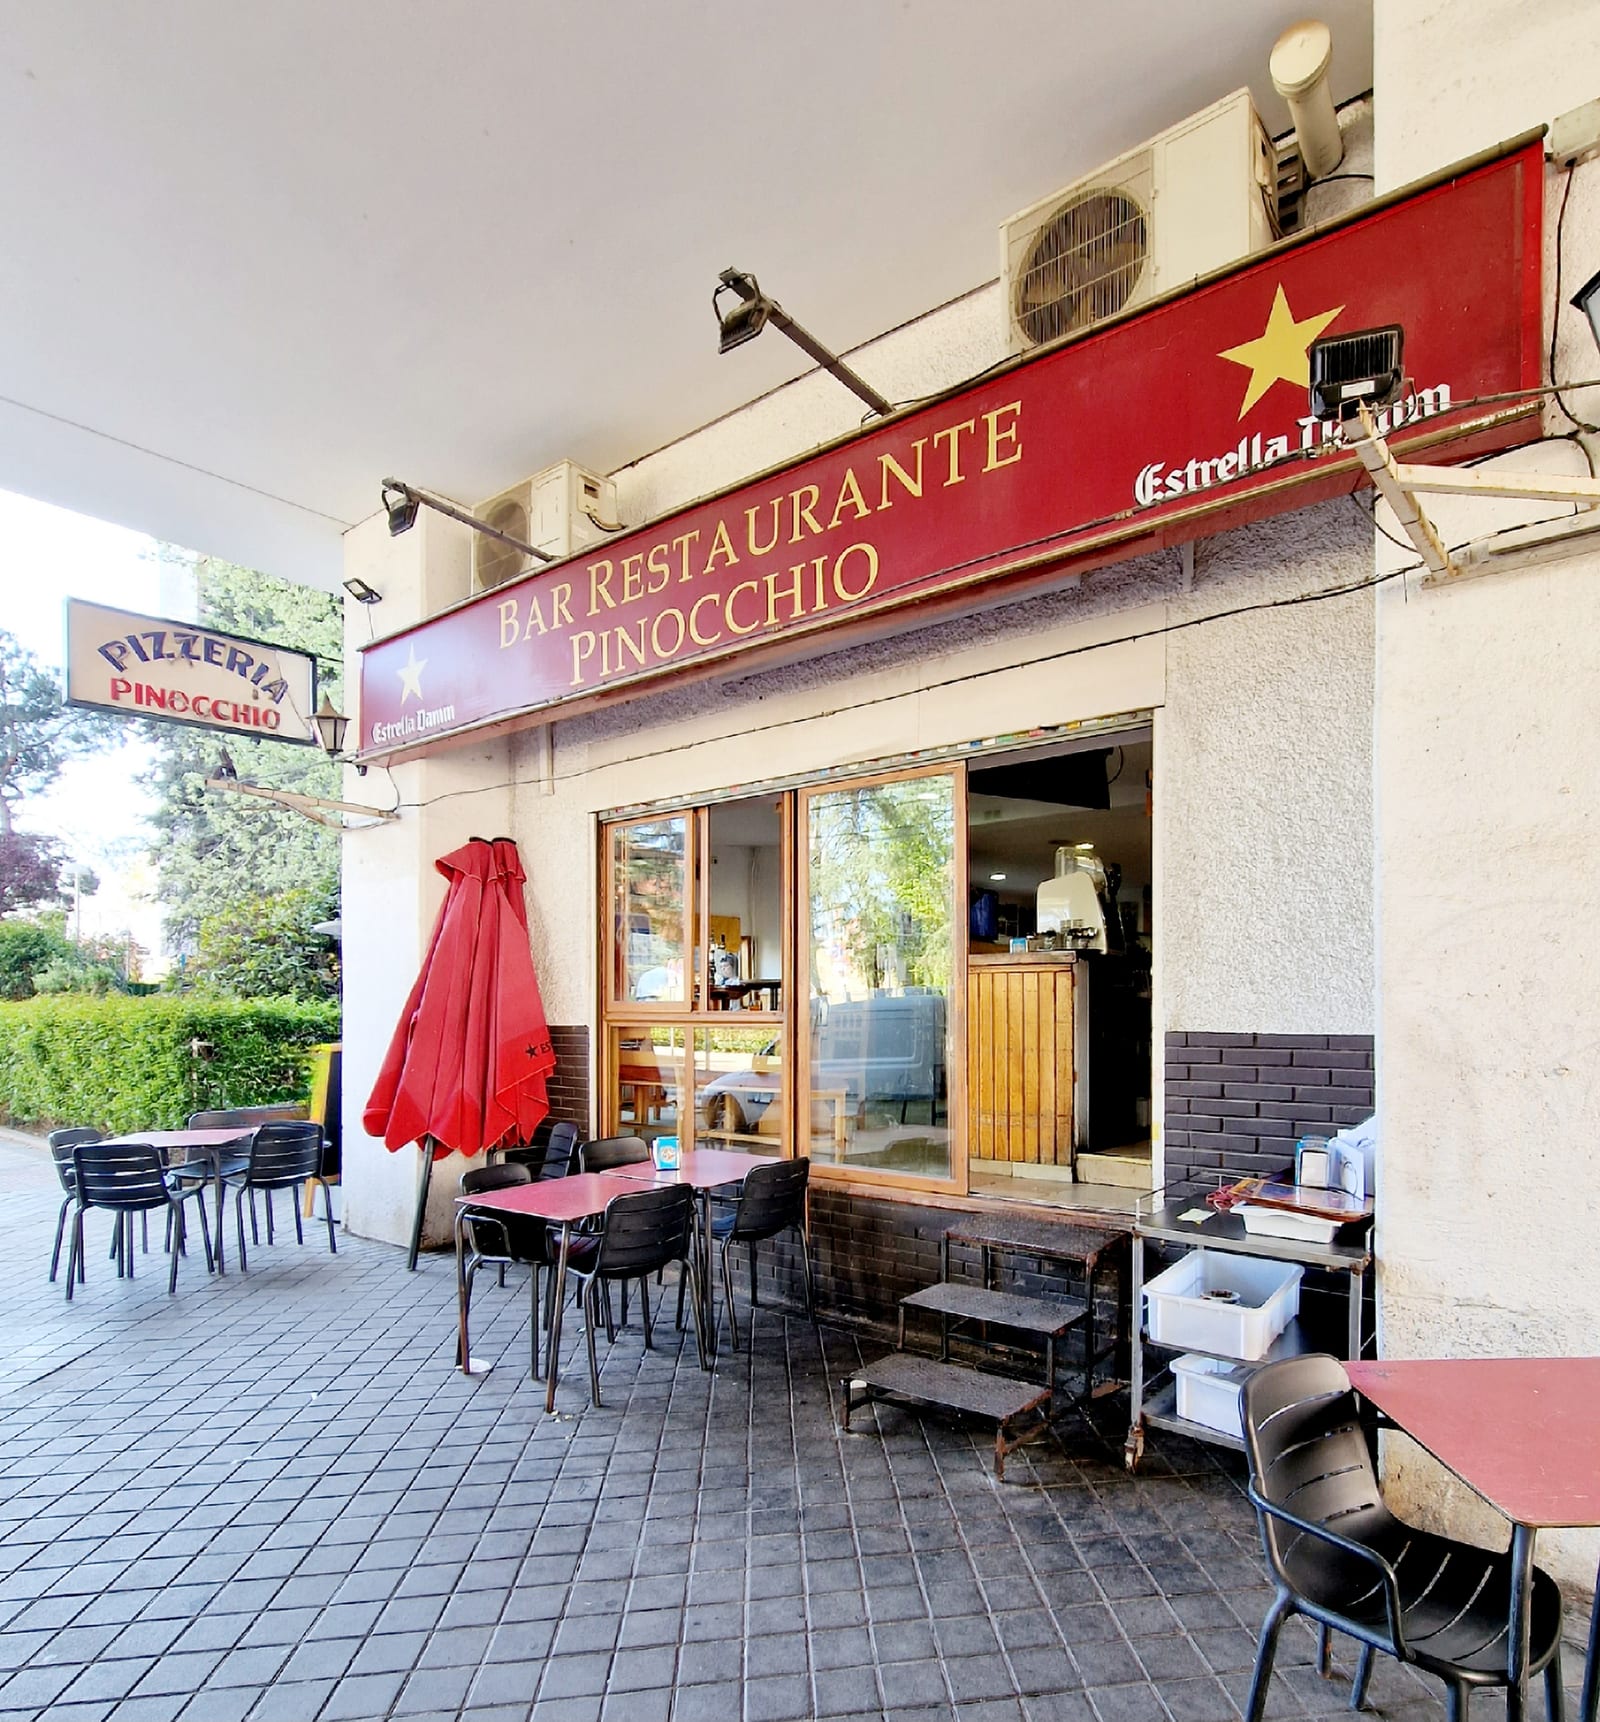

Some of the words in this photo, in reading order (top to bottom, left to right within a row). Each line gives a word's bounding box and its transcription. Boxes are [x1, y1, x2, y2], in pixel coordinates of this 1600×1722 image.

[1134, 431, 1289, 506] Estrella
[497, 583, 575, 649] BAR
[586, 400, 1024, 617] RESTAURANTE
[568, 543, 880, 685] PINOCCHIO
[97, 631, 289, 704] PIZZERIA
[110, 677, 281, 730] PINOCCHIO
[371, 715, 415, 744] Estrella
[416, 704, 456, 732] Damm
